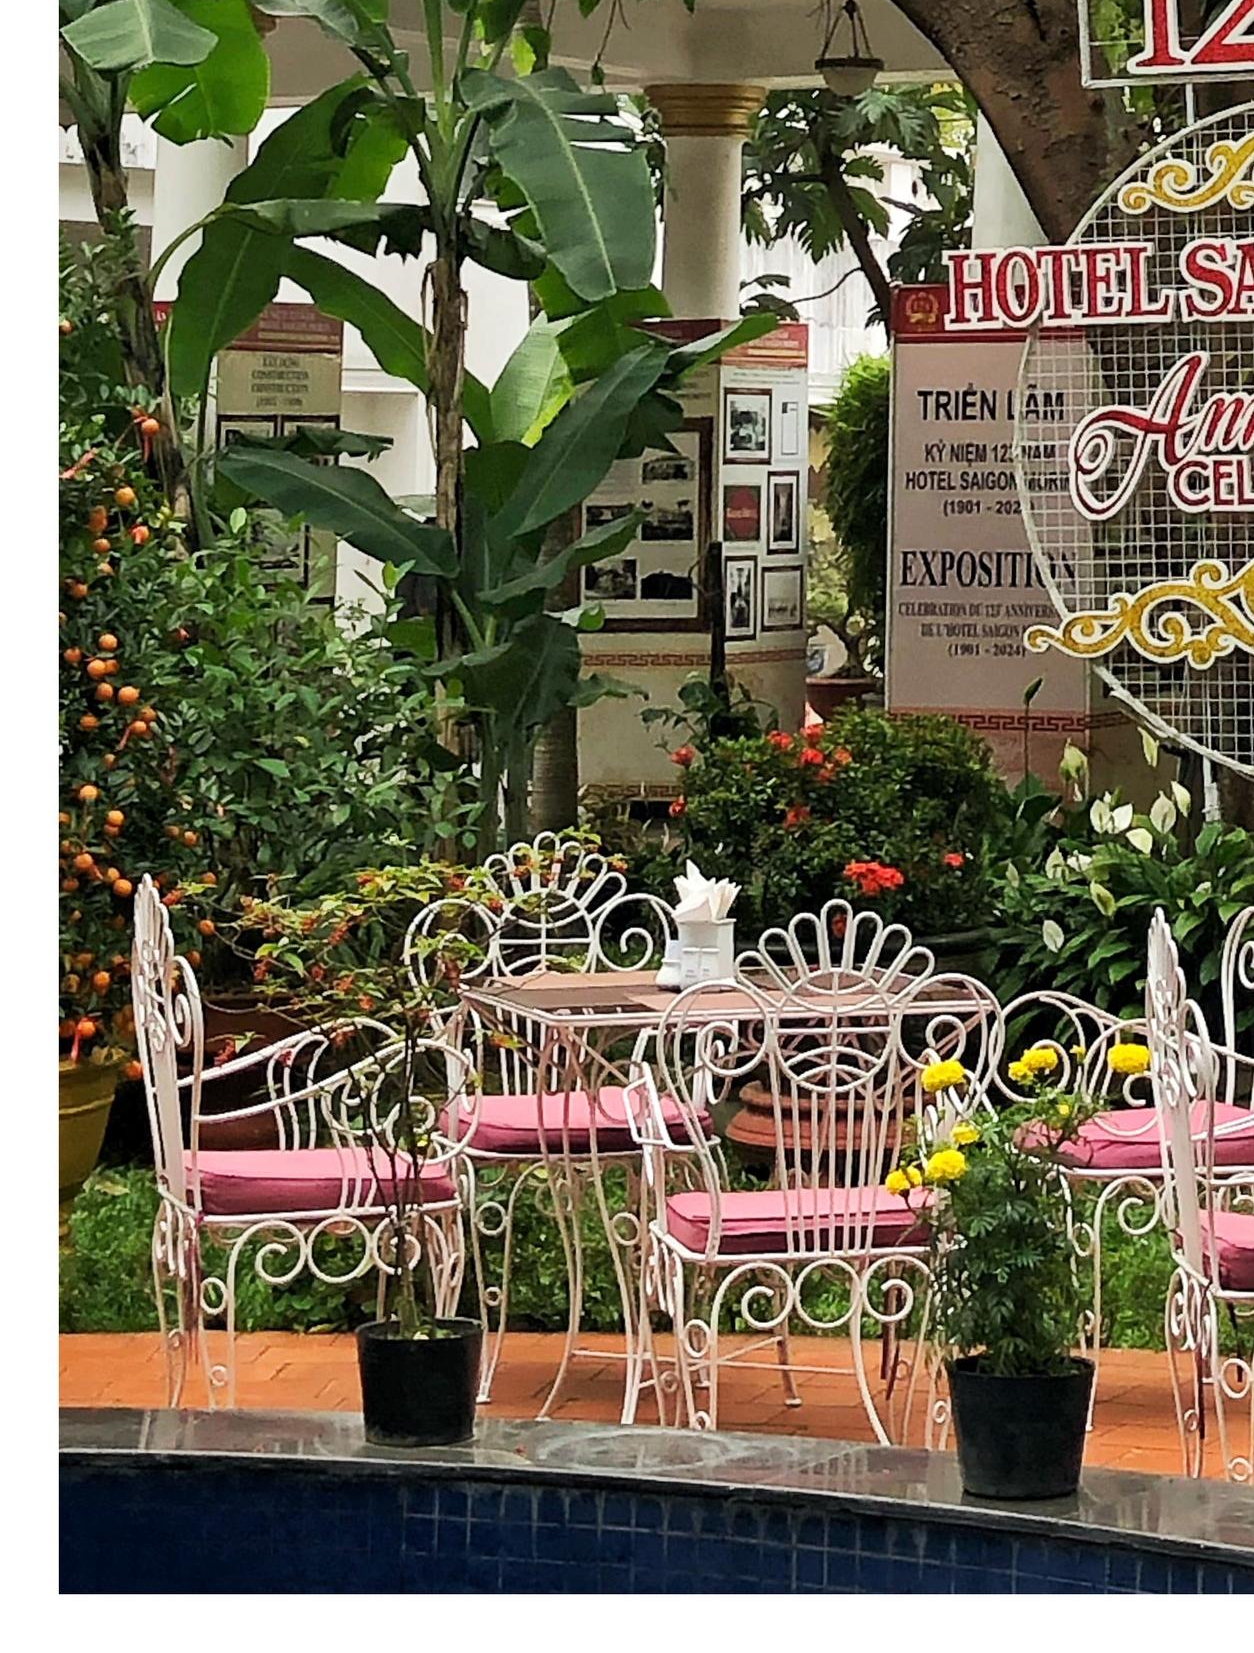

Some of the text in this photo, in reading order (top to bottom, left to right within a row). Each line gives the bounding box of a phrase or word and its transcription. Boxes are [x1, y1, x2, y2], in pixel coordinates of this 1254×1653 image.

[945, 246, 1171, 324] HOTEL
[905, 471, 957, 490] HOTEL
[943, 499, 981, 518] (1901
[995, 500, 1036, 516] 202)
